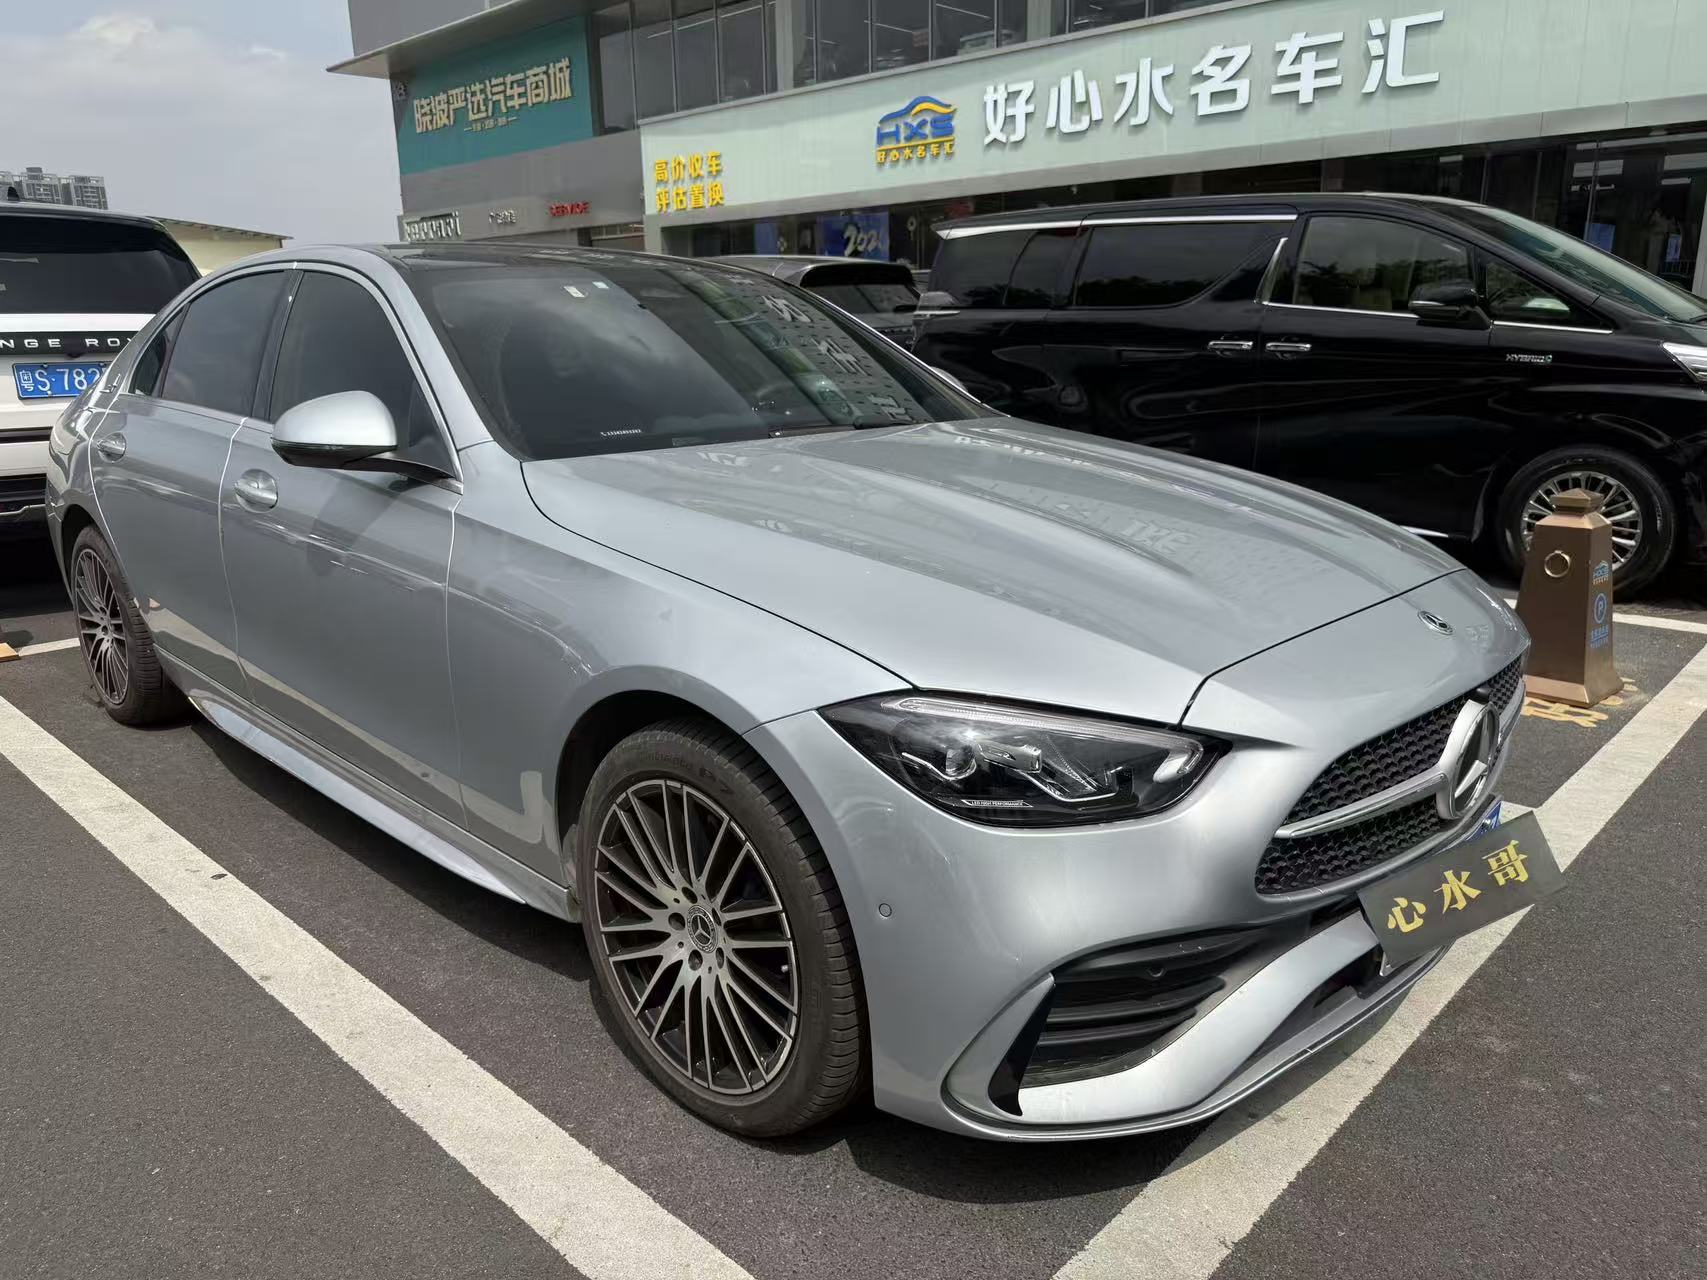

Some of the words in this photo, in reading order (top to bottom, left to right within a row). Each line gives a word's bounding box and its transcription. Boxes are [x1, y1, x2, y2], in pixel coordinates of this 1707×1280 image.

[983, 10, 1445, 146] 好心水名车汇
[413, 57, 572, 133] 晓波严选汽车商城
[877, 114, 954, 146] HXS
[656, 151, 721, 182] 高价收车
[656, 182, 725, 212] 评估置换
[85, 338, 132, 348] RO
[1386, 840, 1529, 933] 心水哥
